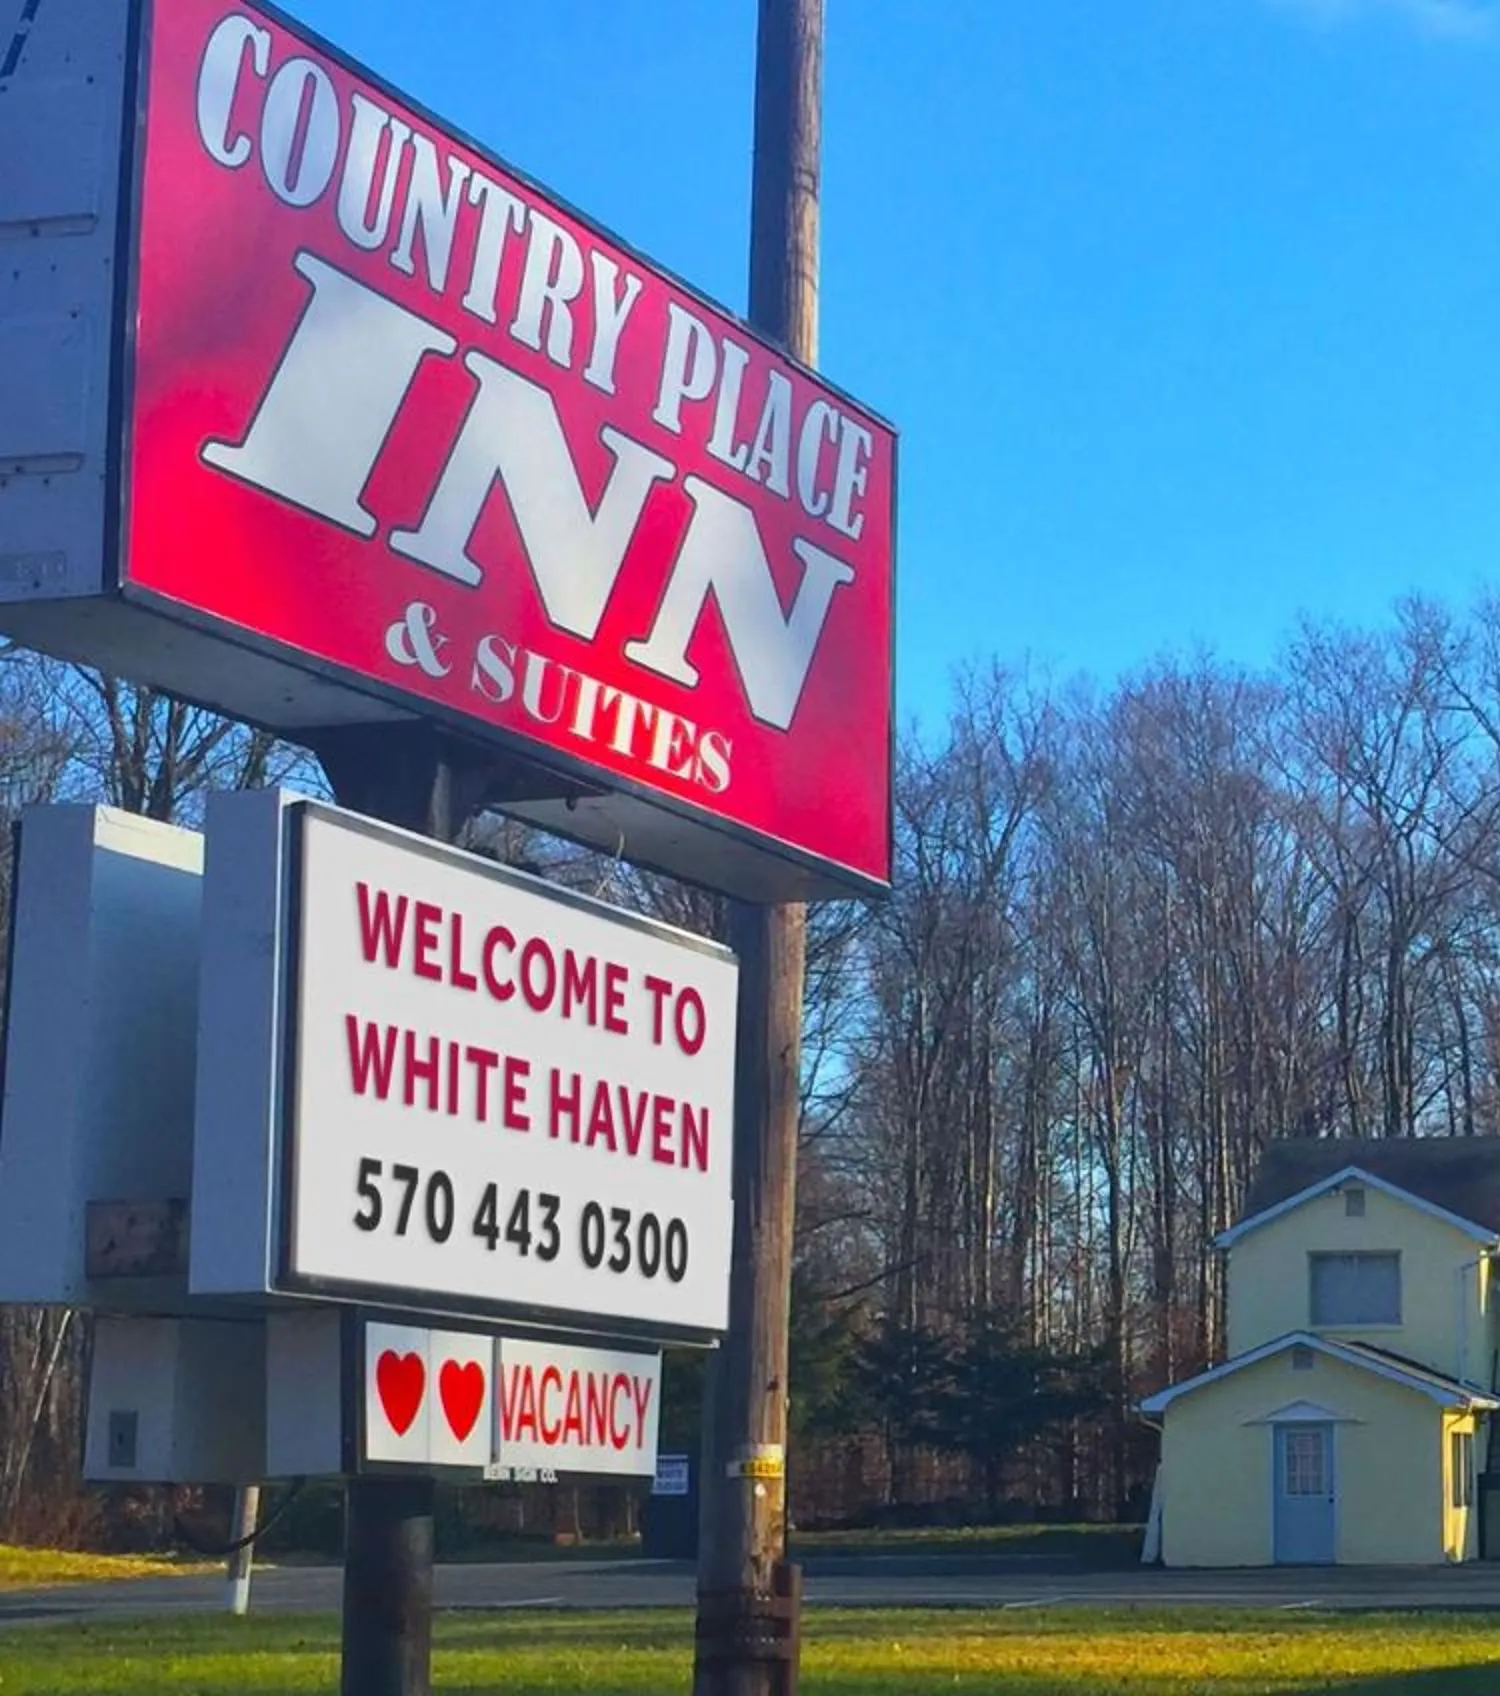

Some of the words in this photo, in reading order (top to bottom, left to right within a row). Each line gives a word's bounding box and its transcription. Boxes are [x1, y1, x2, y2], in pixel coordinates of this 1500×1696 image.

[197, 14, 643, 396] COUNTRY
[651, 301, 874, 541] PLACE
[201, 251, 856, 732] INN
[385, 601, 450, 678] &
[471, 635, 734, 794] SUITES
[356, 881, 629, 1036] WELCOME
[644, 975, 707, 1056] TO
[345, 1014, 531, 1132] WHITE
[549, 1068, 710, 1173] HAVEN
[354, 1157, 455, 1244] 570
[472, 1182, 561, 1262] 443
[580, 1201, 689, 1283] 0300
[499, 1363, 653, 1451] VACANCY
